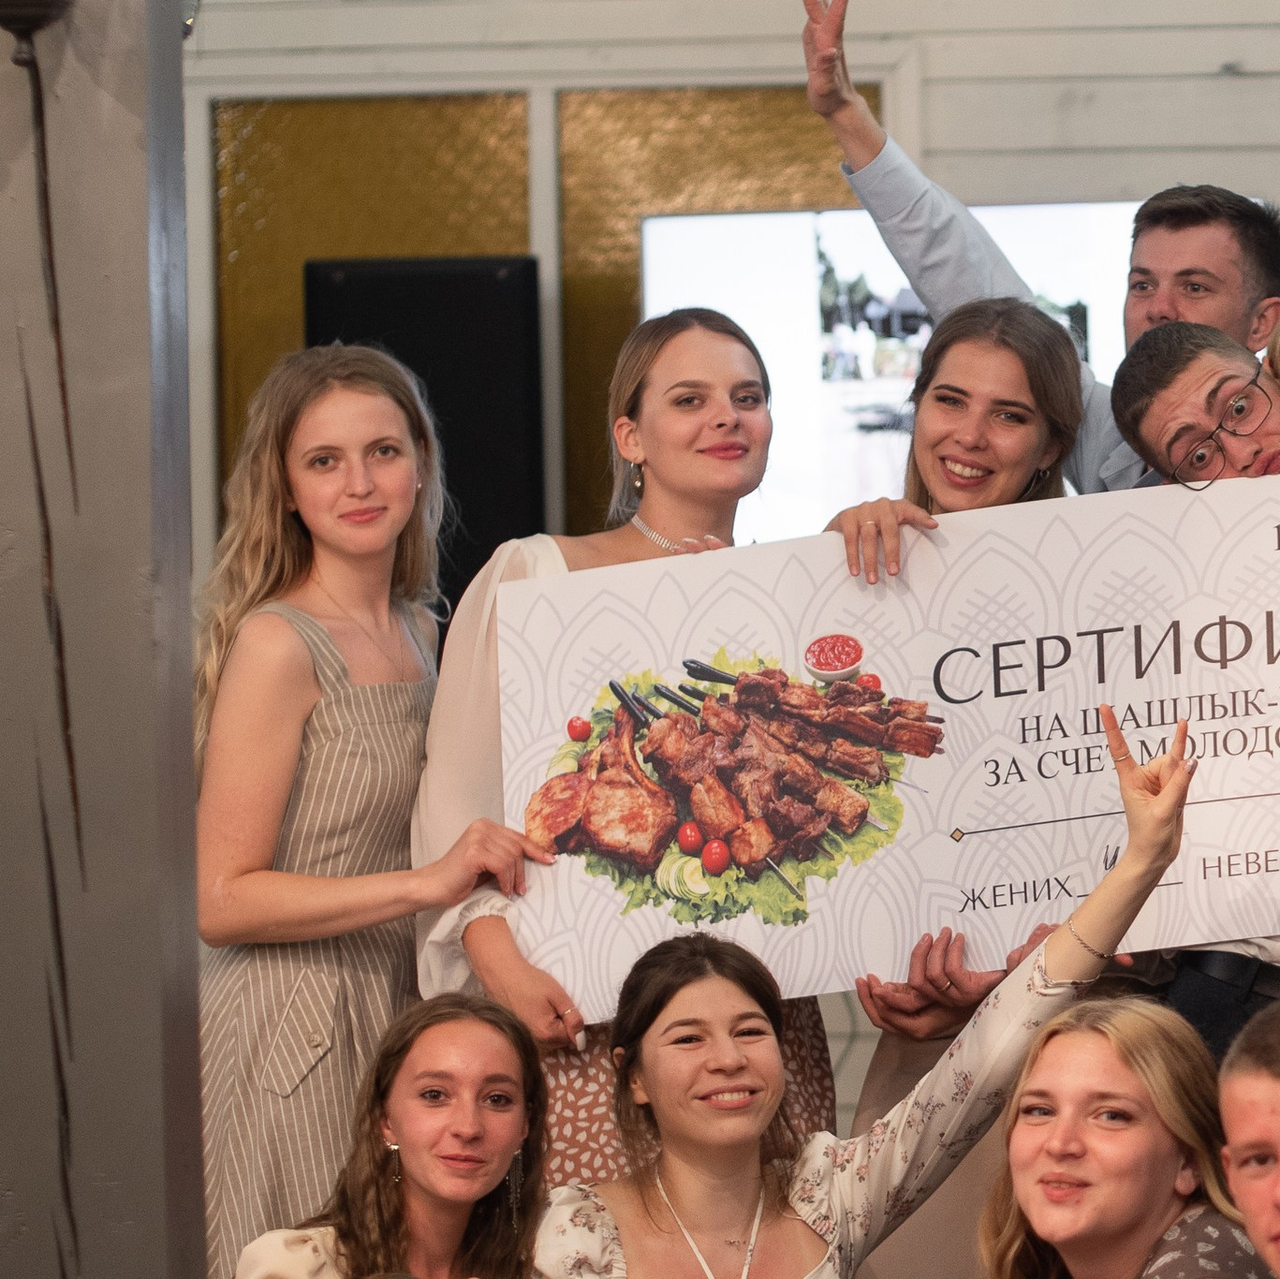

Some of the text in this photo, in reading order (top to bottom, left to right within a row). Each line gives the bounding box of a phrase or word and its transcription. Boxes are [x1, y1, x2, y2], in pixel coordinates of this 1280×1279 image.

[1019, 713, 1069, 744] НА
[984, 756, 1028, 787] ЗА
[1037, 742, 1118, 779] СЧЕ
[959, 875, 1073, 913] ЖЕНИХ
